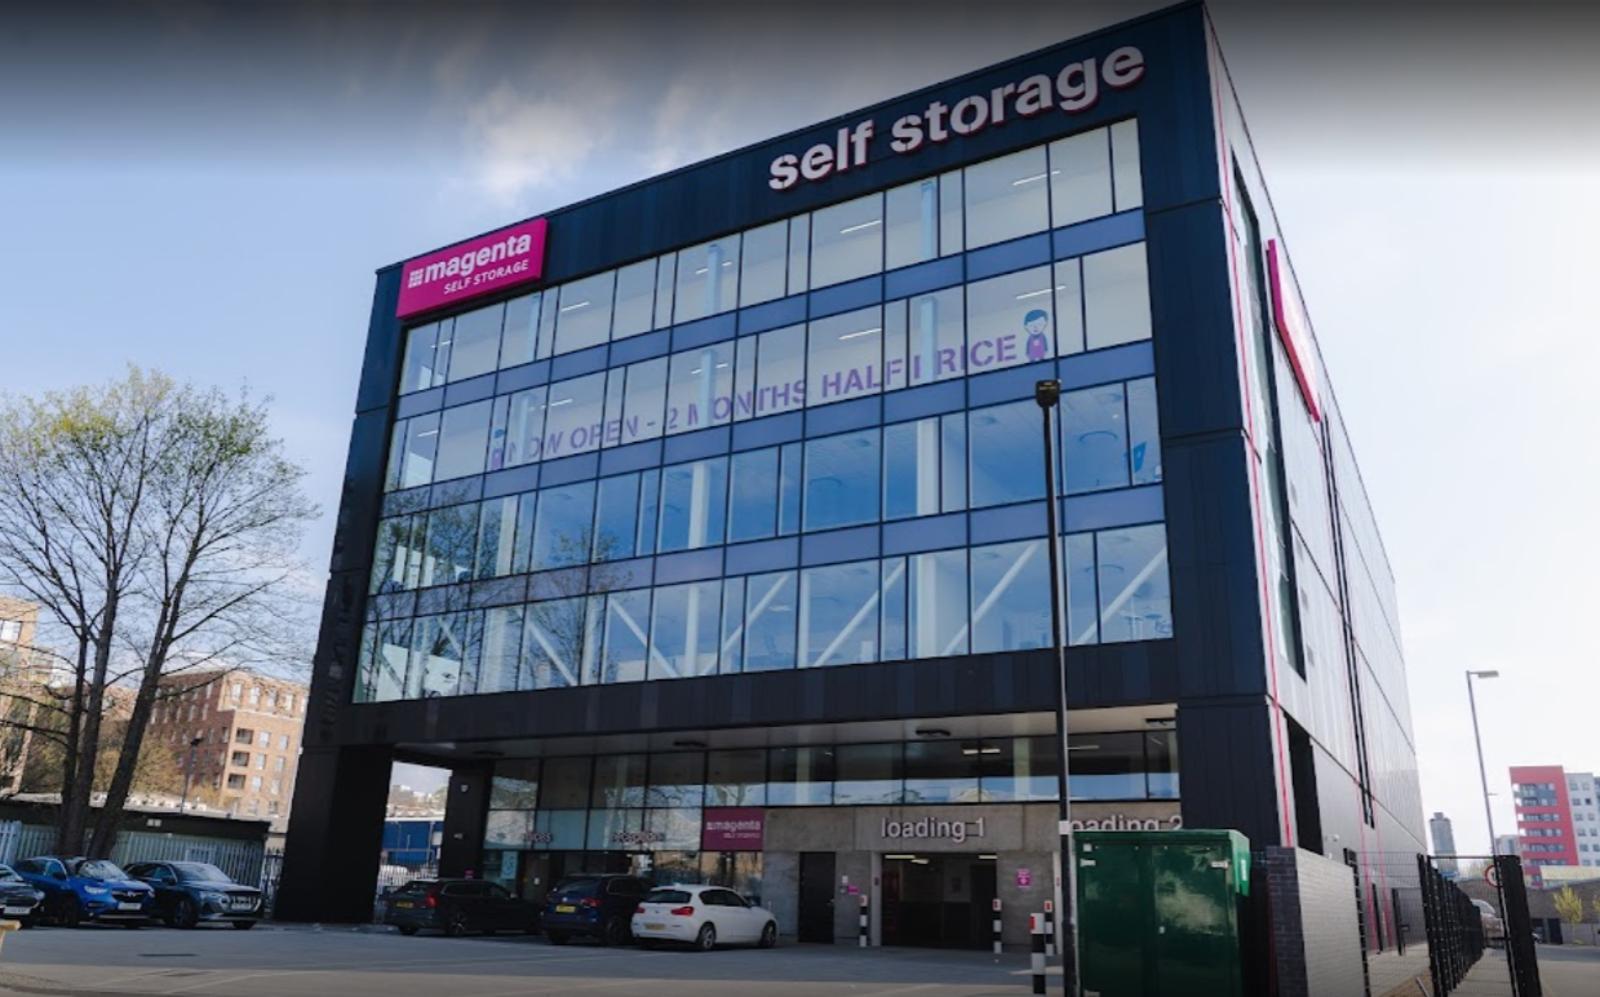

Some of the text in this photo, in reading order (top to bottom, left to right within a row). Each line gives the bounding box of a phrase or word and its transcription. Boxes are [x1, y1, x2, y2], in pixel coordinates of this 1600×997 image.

[769, 46, 1145, 190] self storage
[424, 234, 531, 283] magenta
[443, 260, 529, 295] SELF STORAGE
[570, 416, 638, 449] OPEN
[669, 407, 678, 429] 2
[822, 359, 903, 397] HALF
[714, 820, 761, 832] magenta
[881, 817, 985, 843] loading 1
[1070, 814, 1182, 831] oading 2
